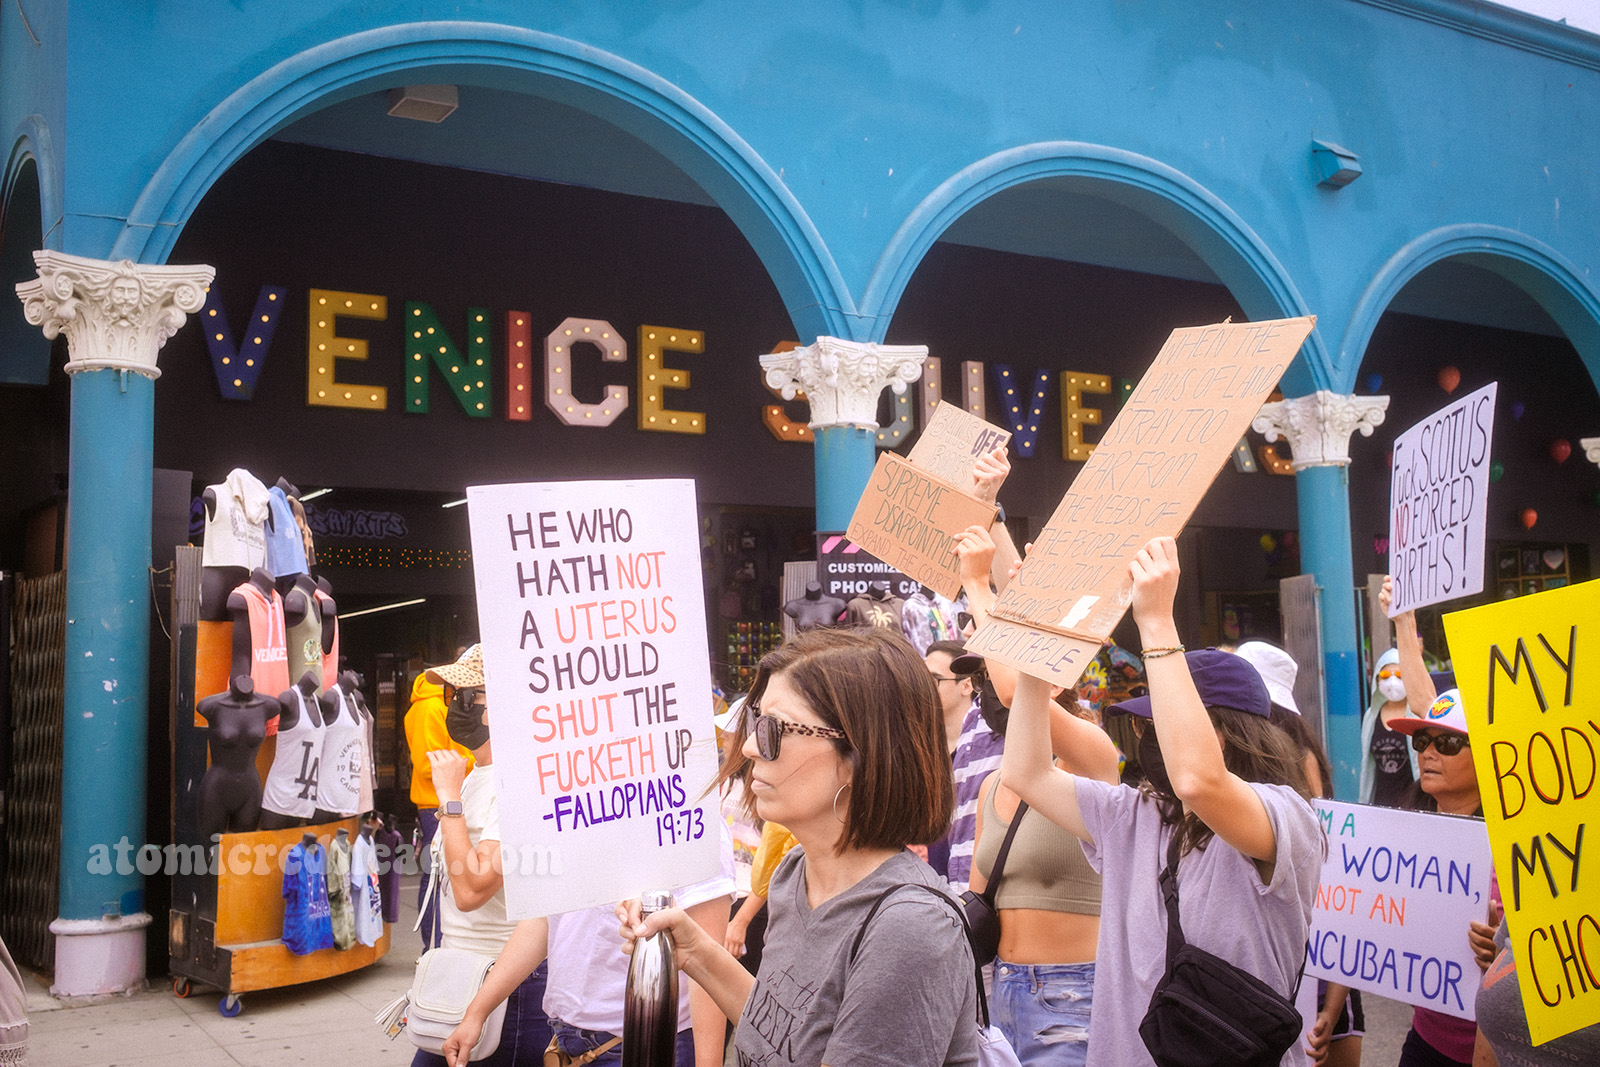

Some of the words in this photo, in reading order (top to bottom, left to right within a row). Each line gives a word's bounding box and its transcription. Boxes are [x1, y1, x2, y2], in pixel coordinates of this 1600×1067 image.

[199, 281, 706, 434] VENICE
[1158, 327, 1234, 365] WHEN
[1234, 324, 1285, 358] THE
[1133, 368, 1197, 404] LAWS
[1192, 365, 1236, 400] OF
[1223, 364, 1284, 399] LAND
[971, 428, 1007, 458] OFF
[1103, 408, 1184, 446] STRAY
[1171, 409, 1229, 444] TOO
[1419, 396, 1490, 493] SCOTUS
[877, 460, 950, 524] SUPREME
[1083, 451, 1133, 491] FAR
[1119, 451, 1198, 491] FROM
[507, 511, 560, 551] HE
[567, 508, 633, 544] WHO
[1053, 493, 1093, 523] THE
[1083, 494, 1149, 525] NEEDS
[1145, 502, 1181, 527] OF
[1394, 502, 1409, 553] NO
[1411, 475, 1474, 544] FORCED
[850, 522, 892, 557] EXPAND
[895, 547, 919, 573] THE
[874, 499, 961, 575] DISAPPOINTMEN
[1033, 528, 1072, 557] THE
[1069, 529, 1140, 558] PEOPLE
[517, 554, 609, 598] HATH
[616, 551, 666, 590] NOT
[830, 580, 891, 594] PHOE
[519, 610, 544, 650] A
[555, 596, 677, 644] UTERUS
[970, 623, 1081, 673] INEVITABLE
[528, 641, 659, 693] SHOULD
[1487, 624, 1577, 726] MY
[531, 692, 618, 743] SHUT
[624, 682, 678, 727] THE
[536, 733, 656, 795] FUCKETH
[665, 728, 693, 770] UP
[656, 807, 705, 847] 19:73
[1314, 808, 1333, 835] 'M
[1340, 813, 1355, 838] A
[1341, 843, 1480, 904] WOMAN,
[1511, 823, 1585, 911] MY
[1316, 884, 1361, 915] NOT
[1369, 893, 1406, 926] AN
[1308, 930, 1465, 1011] NCUBATOR
